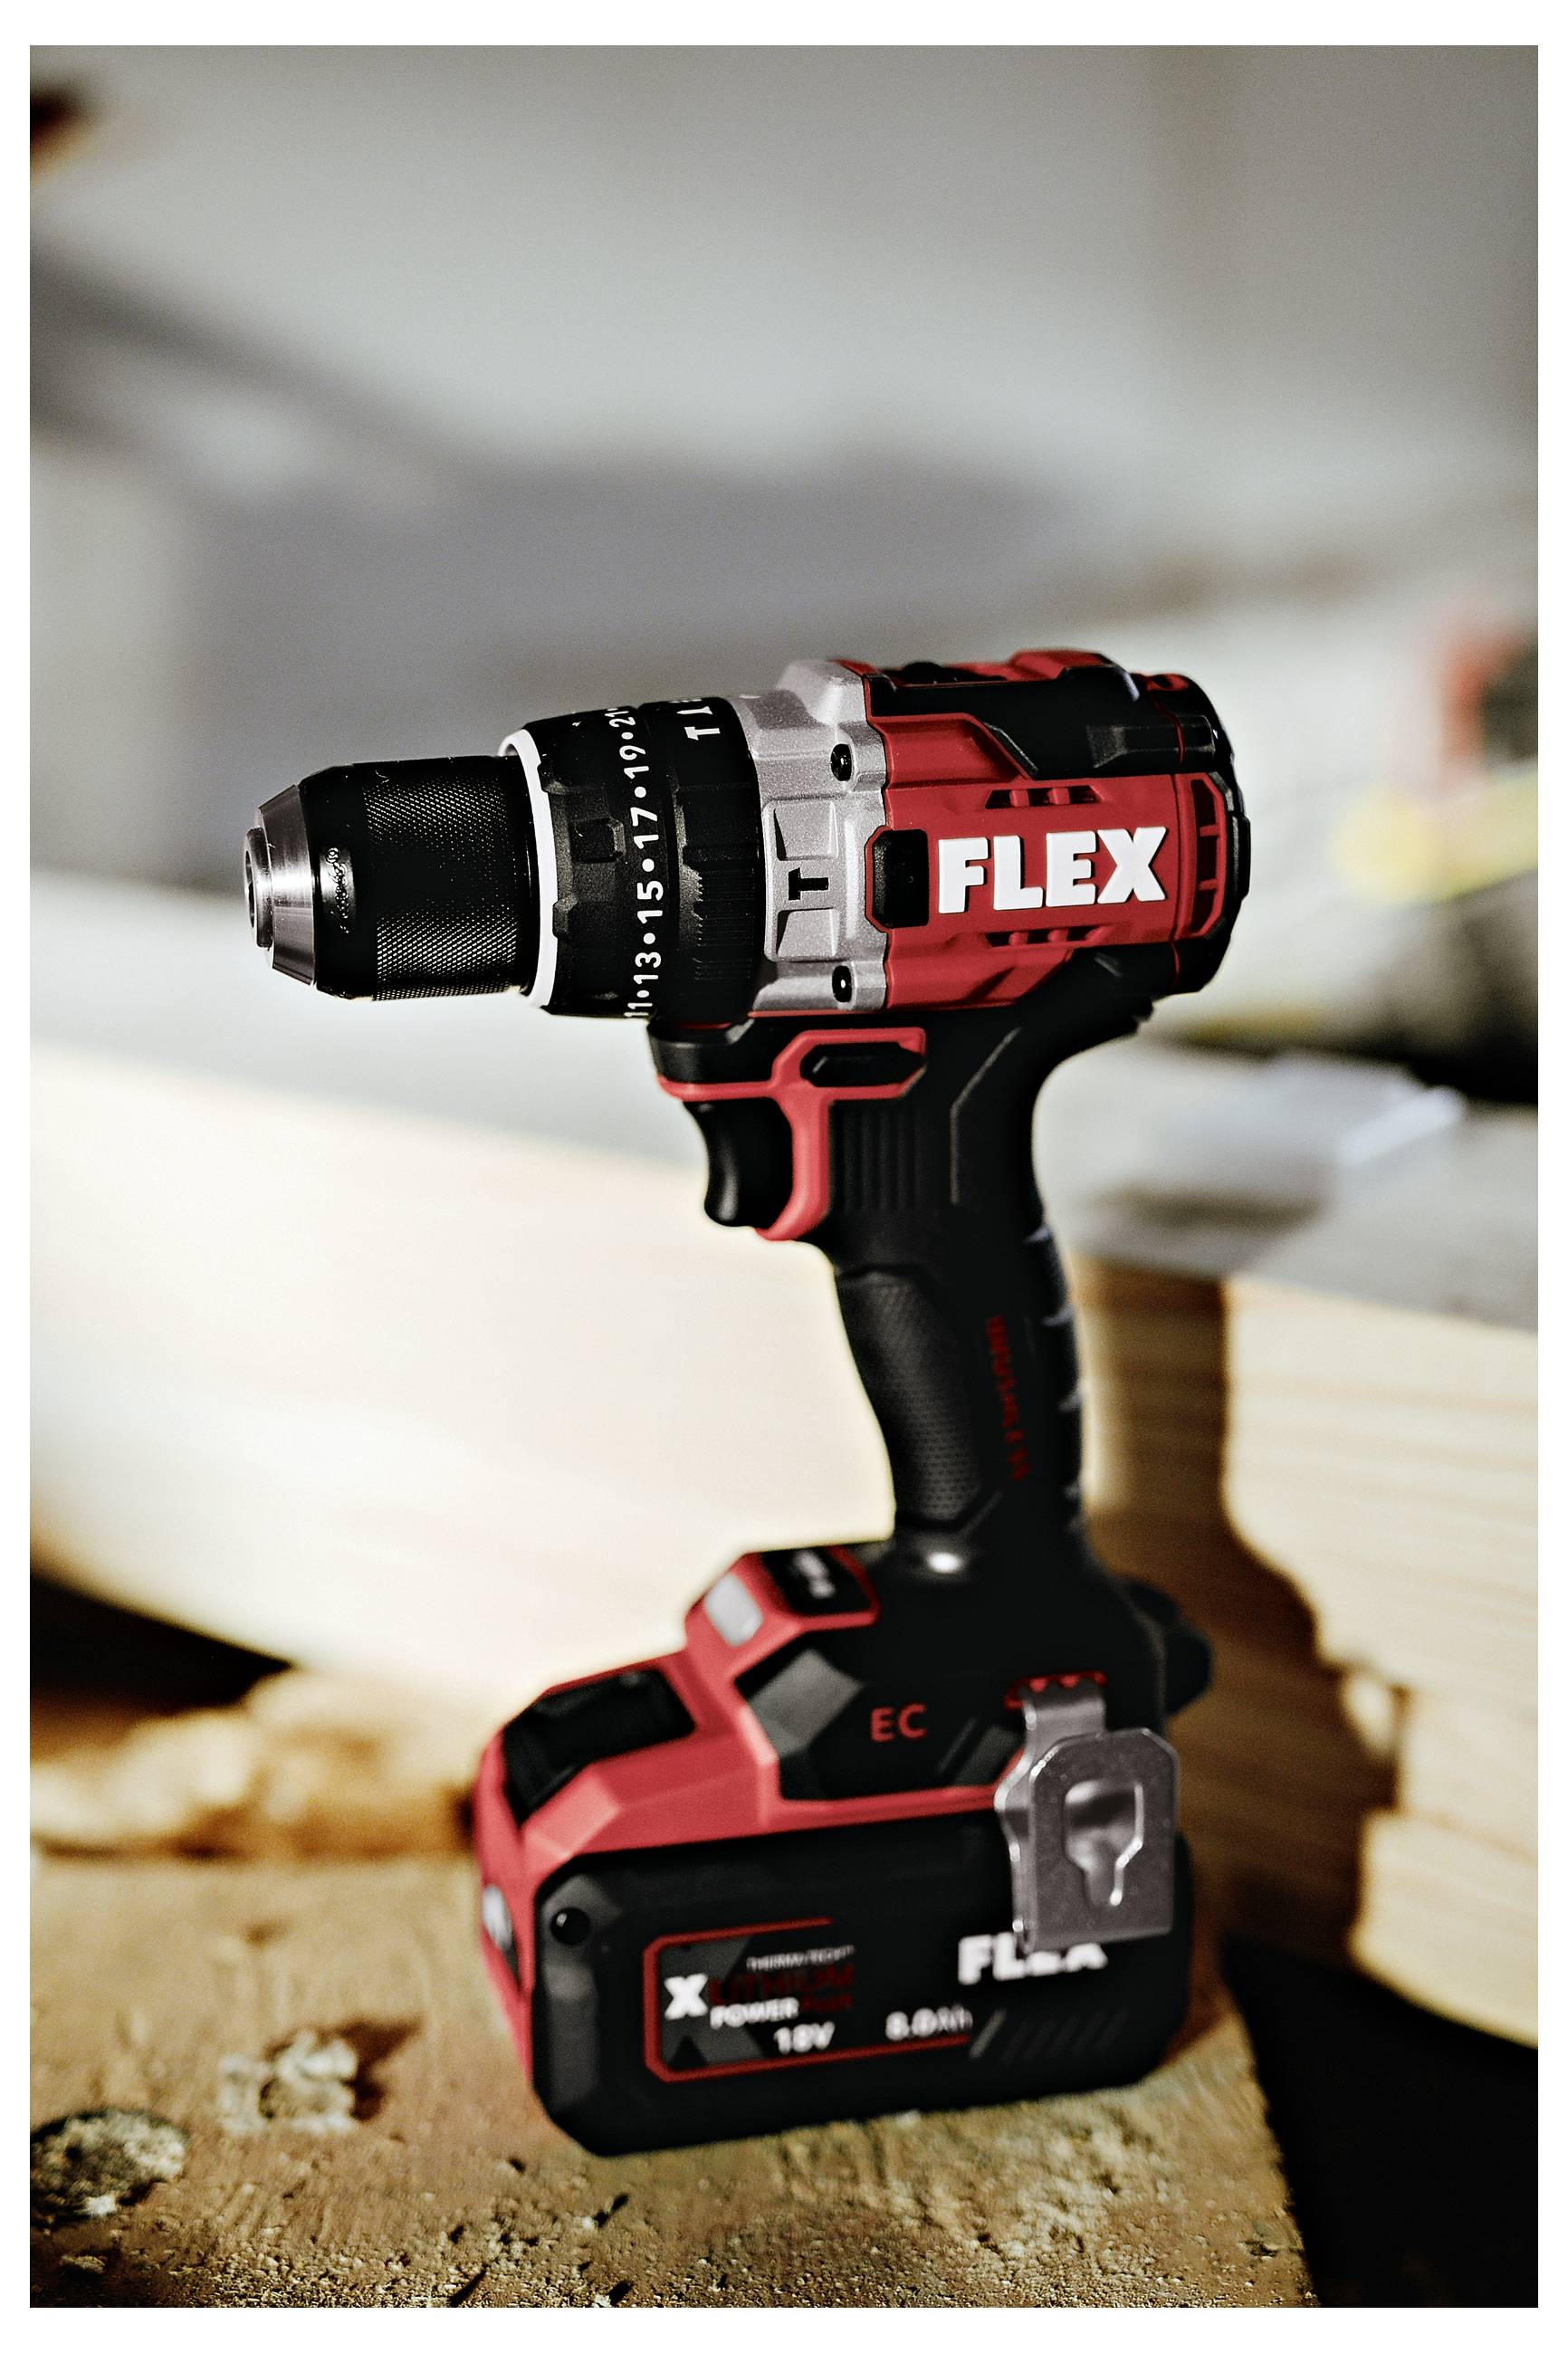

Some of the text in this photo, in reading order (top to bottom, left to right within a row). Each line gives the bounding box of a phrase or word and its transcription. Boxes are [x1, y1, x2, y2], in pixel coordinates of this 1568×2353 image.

[619, 744, 650, 780] 19
[630, 806, 660, 849] 17
[938, 826, 1167, 914] FLEX
[636, 880, 664, 925] 15
[633, 951, 662, 985] 13
[870, 1703, 928, 1743] EC
[709, 1995, 801, 2030] POWER
